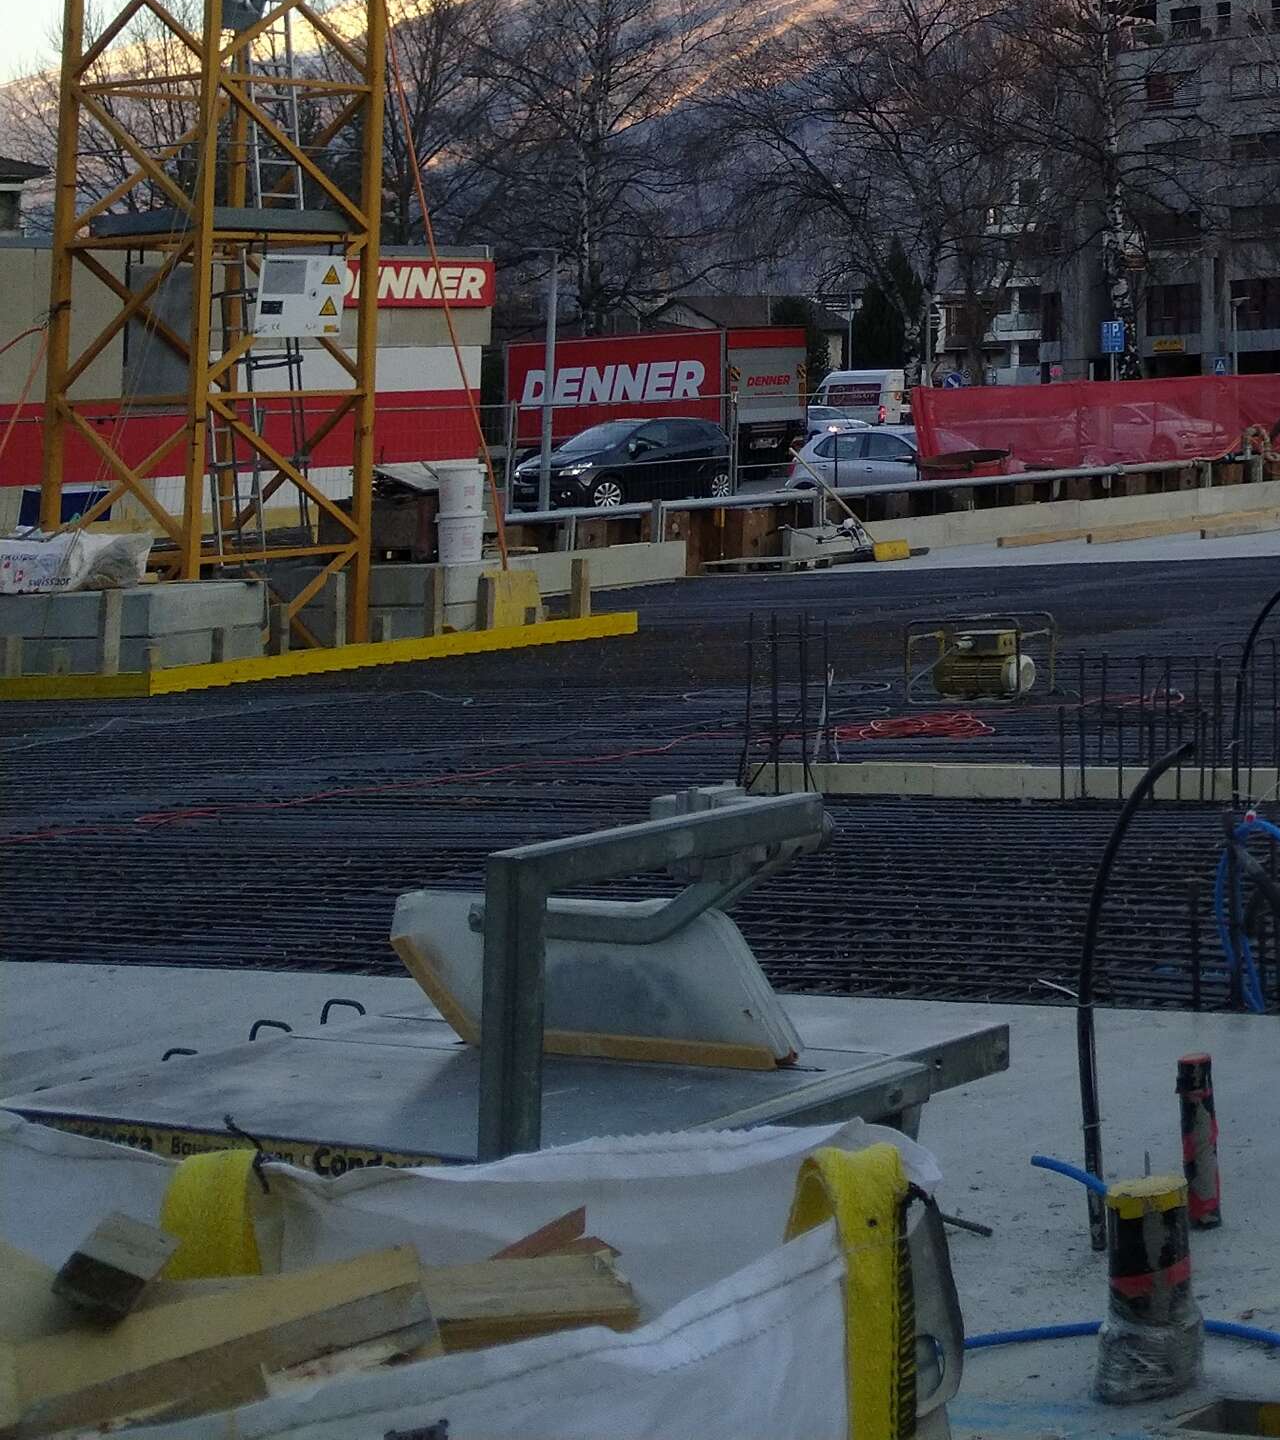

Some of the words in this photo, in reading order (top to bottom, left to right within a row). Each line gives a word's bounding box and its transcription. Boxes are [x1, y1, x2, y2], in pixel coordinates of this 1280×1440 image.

[1112, 322, 1120, 337] P
[520, 359, 706, 410] DENNER
[746, 374, 791, 387] DENNER
